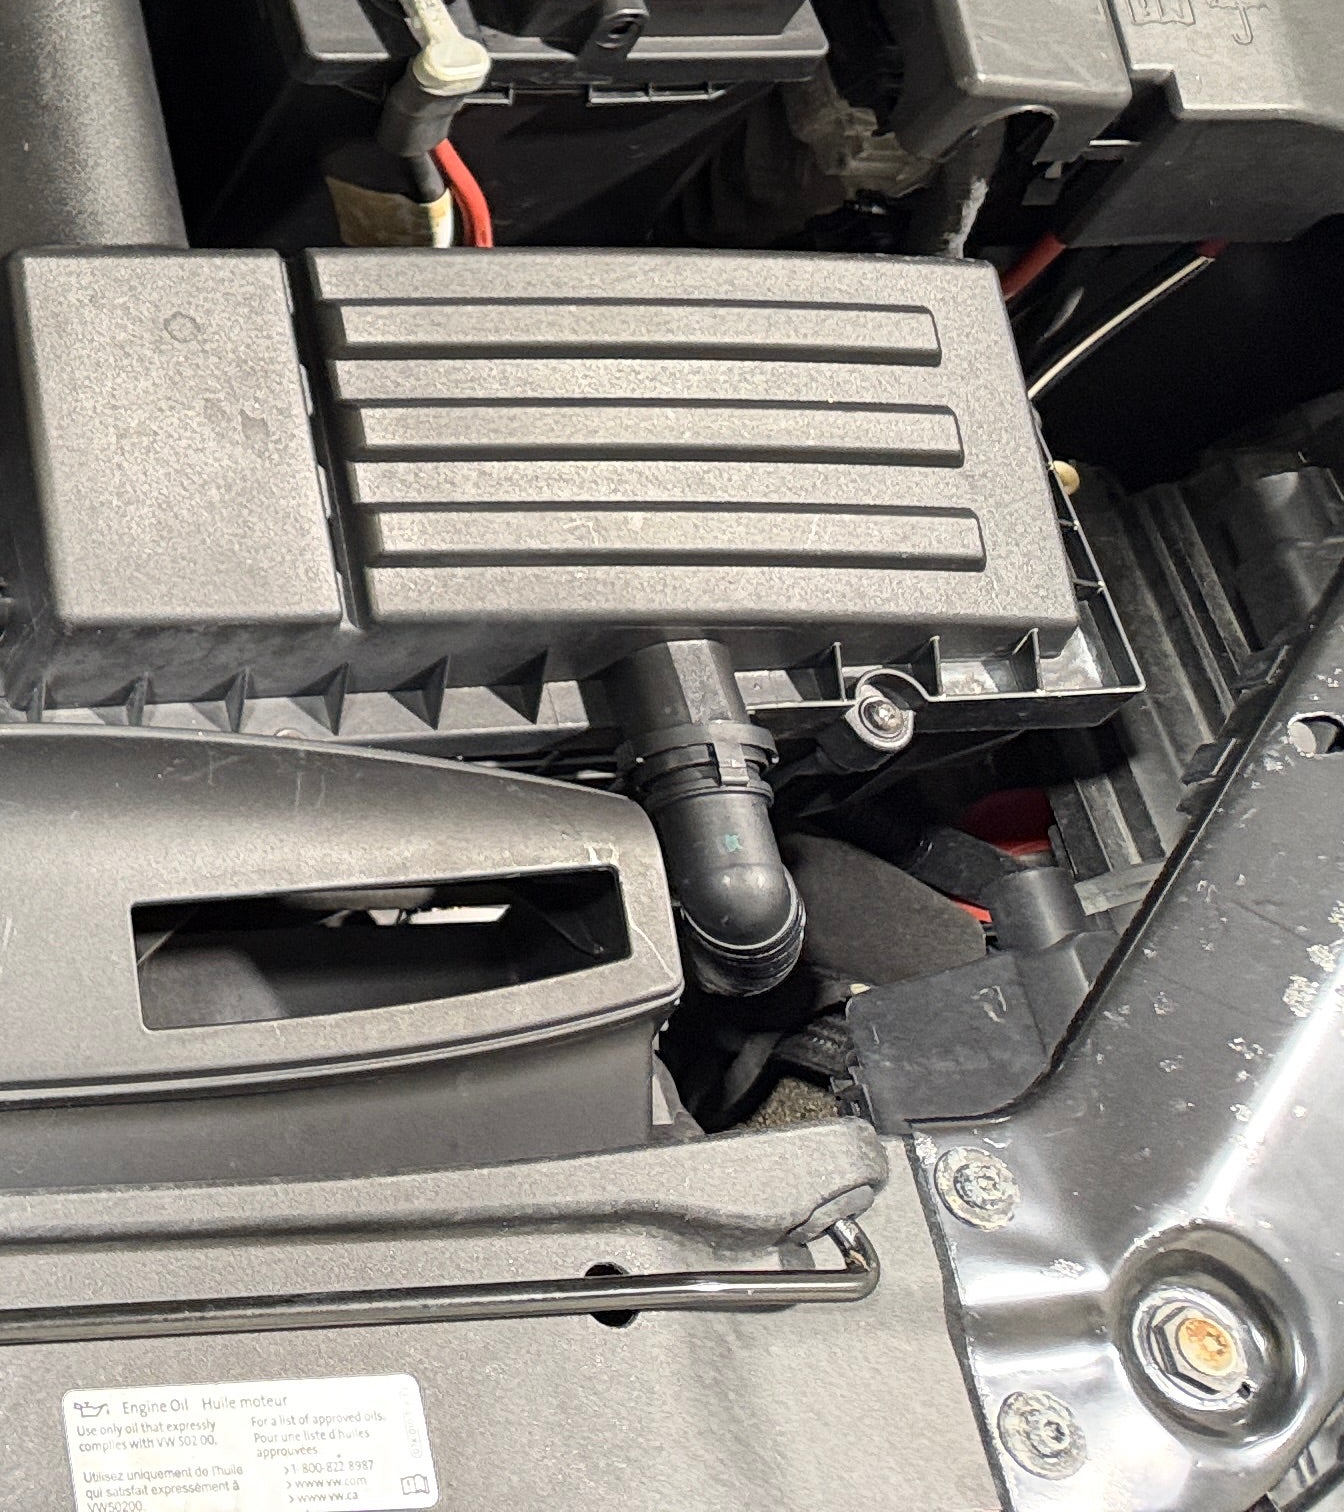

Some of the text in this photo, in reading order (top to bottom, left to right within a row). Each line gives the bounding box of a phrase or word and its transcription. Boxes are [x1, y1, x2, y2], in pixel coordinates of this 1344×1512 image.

[122, 1395, 287, 1418] Engine Oil Huile moteur
[251, 1417, 268, 1427] For
[271, 1418, 277, 1426] a
[279, 1415, 296, 1426] list
[299, 1414, 309, 1425] of
[313, 1411, 361, 1426] approved
[77, 1419, 216, 1437] Use only oil that expressly
[79, 1440, 127, 1453] complies
[130, 1438, 154, 1449] with
[157, 1437, 175, 1448] VW
[179, 1436, 198, 1447] 502
[254, 1433, 278, 1444] Pour
[282, 1432, 301, 1442] une
[303, 1430, 326, 1441] liste
[83, 1469, 124, 1484] Utilisez
[86, 1487, 103, 1500] qui
[106, 1485, 148, 1498] satisfait
